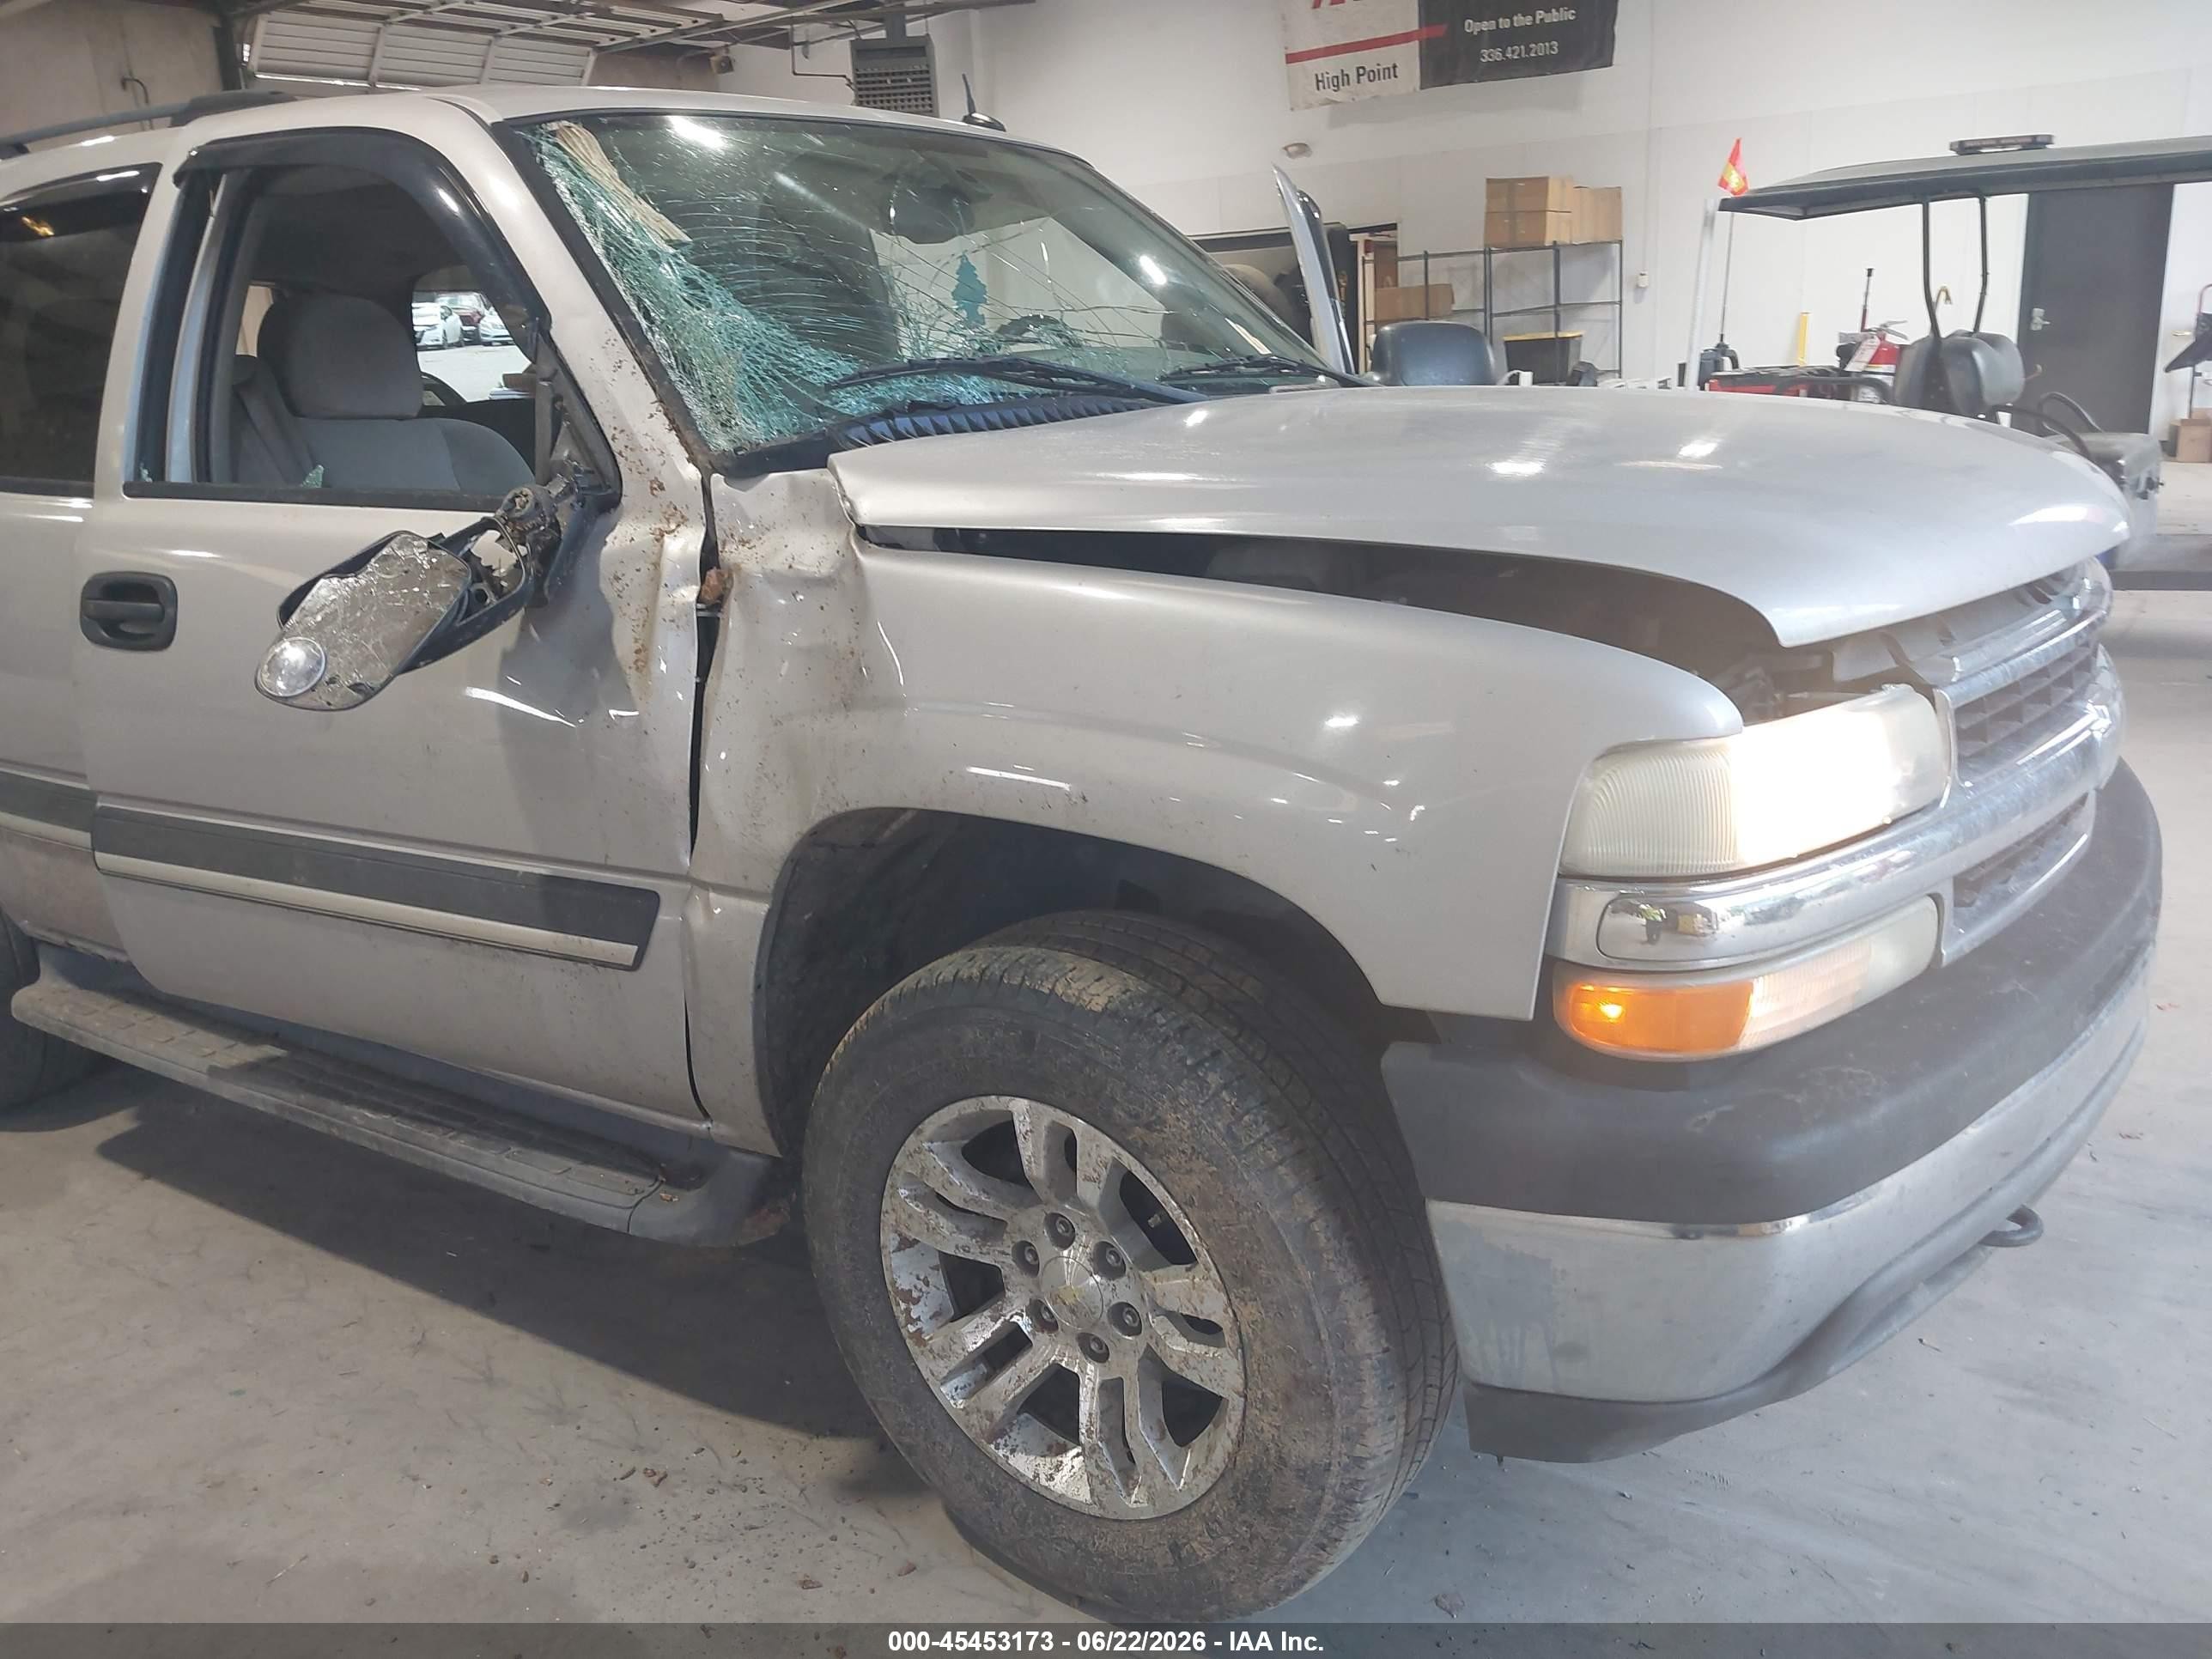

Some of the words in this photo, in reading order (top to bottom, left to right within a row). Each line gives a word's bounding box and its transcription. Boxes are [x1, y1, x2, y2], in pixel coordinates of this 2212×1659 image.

[1464, 19, 1497, 35] Open
[1498, 17, 1511, 28] to
[1513, 13, 1534, 27] the
[1535, 7, 1577, 24] Public
[1480, 40, 1559, 63] 336.421.2013
[1315, 68, 1351, 92] High
[1356, 63, 1399, 84] Point
